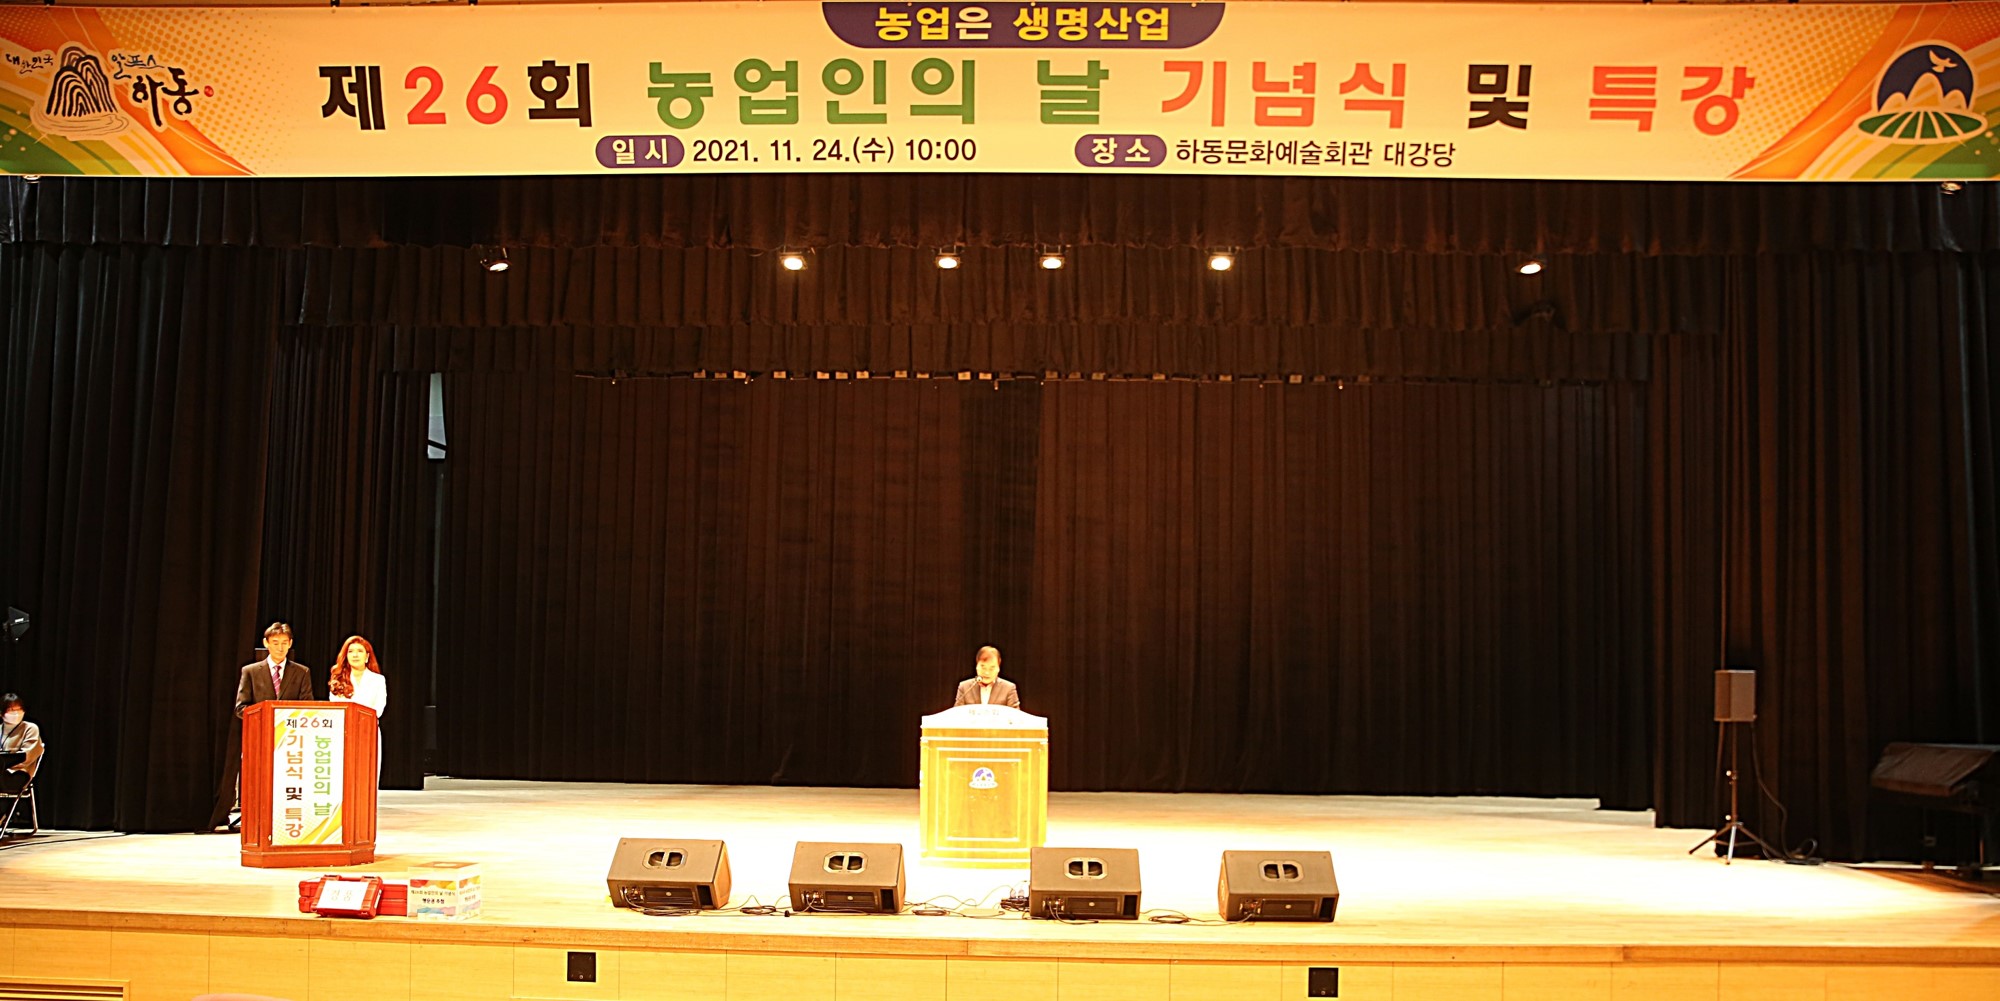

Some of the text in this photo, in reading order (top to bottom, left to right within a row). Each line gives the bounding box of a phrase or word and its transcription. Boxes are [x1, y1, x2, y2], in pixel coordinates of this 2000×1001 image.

[874, 6, 1170, 42] 농업은 생명산업
[5, 53, 54, 75] 대한민국
[111, 53, 165, 80] 알프스
[131, 66, 200, 127] 하동
[318, 57, 1757, 136] 제26회 농업인의 날 기념식 및 특강
[692, 135, 977, 165] 2021. 11. 24.(수) 10:00
[1175, 138, 1457, 169] 하동문화예술회관 대강당
[286, 717, 334, 729] 제26회
[285, 734, 304, 838] 기념식 및 특강
[313, 735, 332, 817] 농업인의 날
